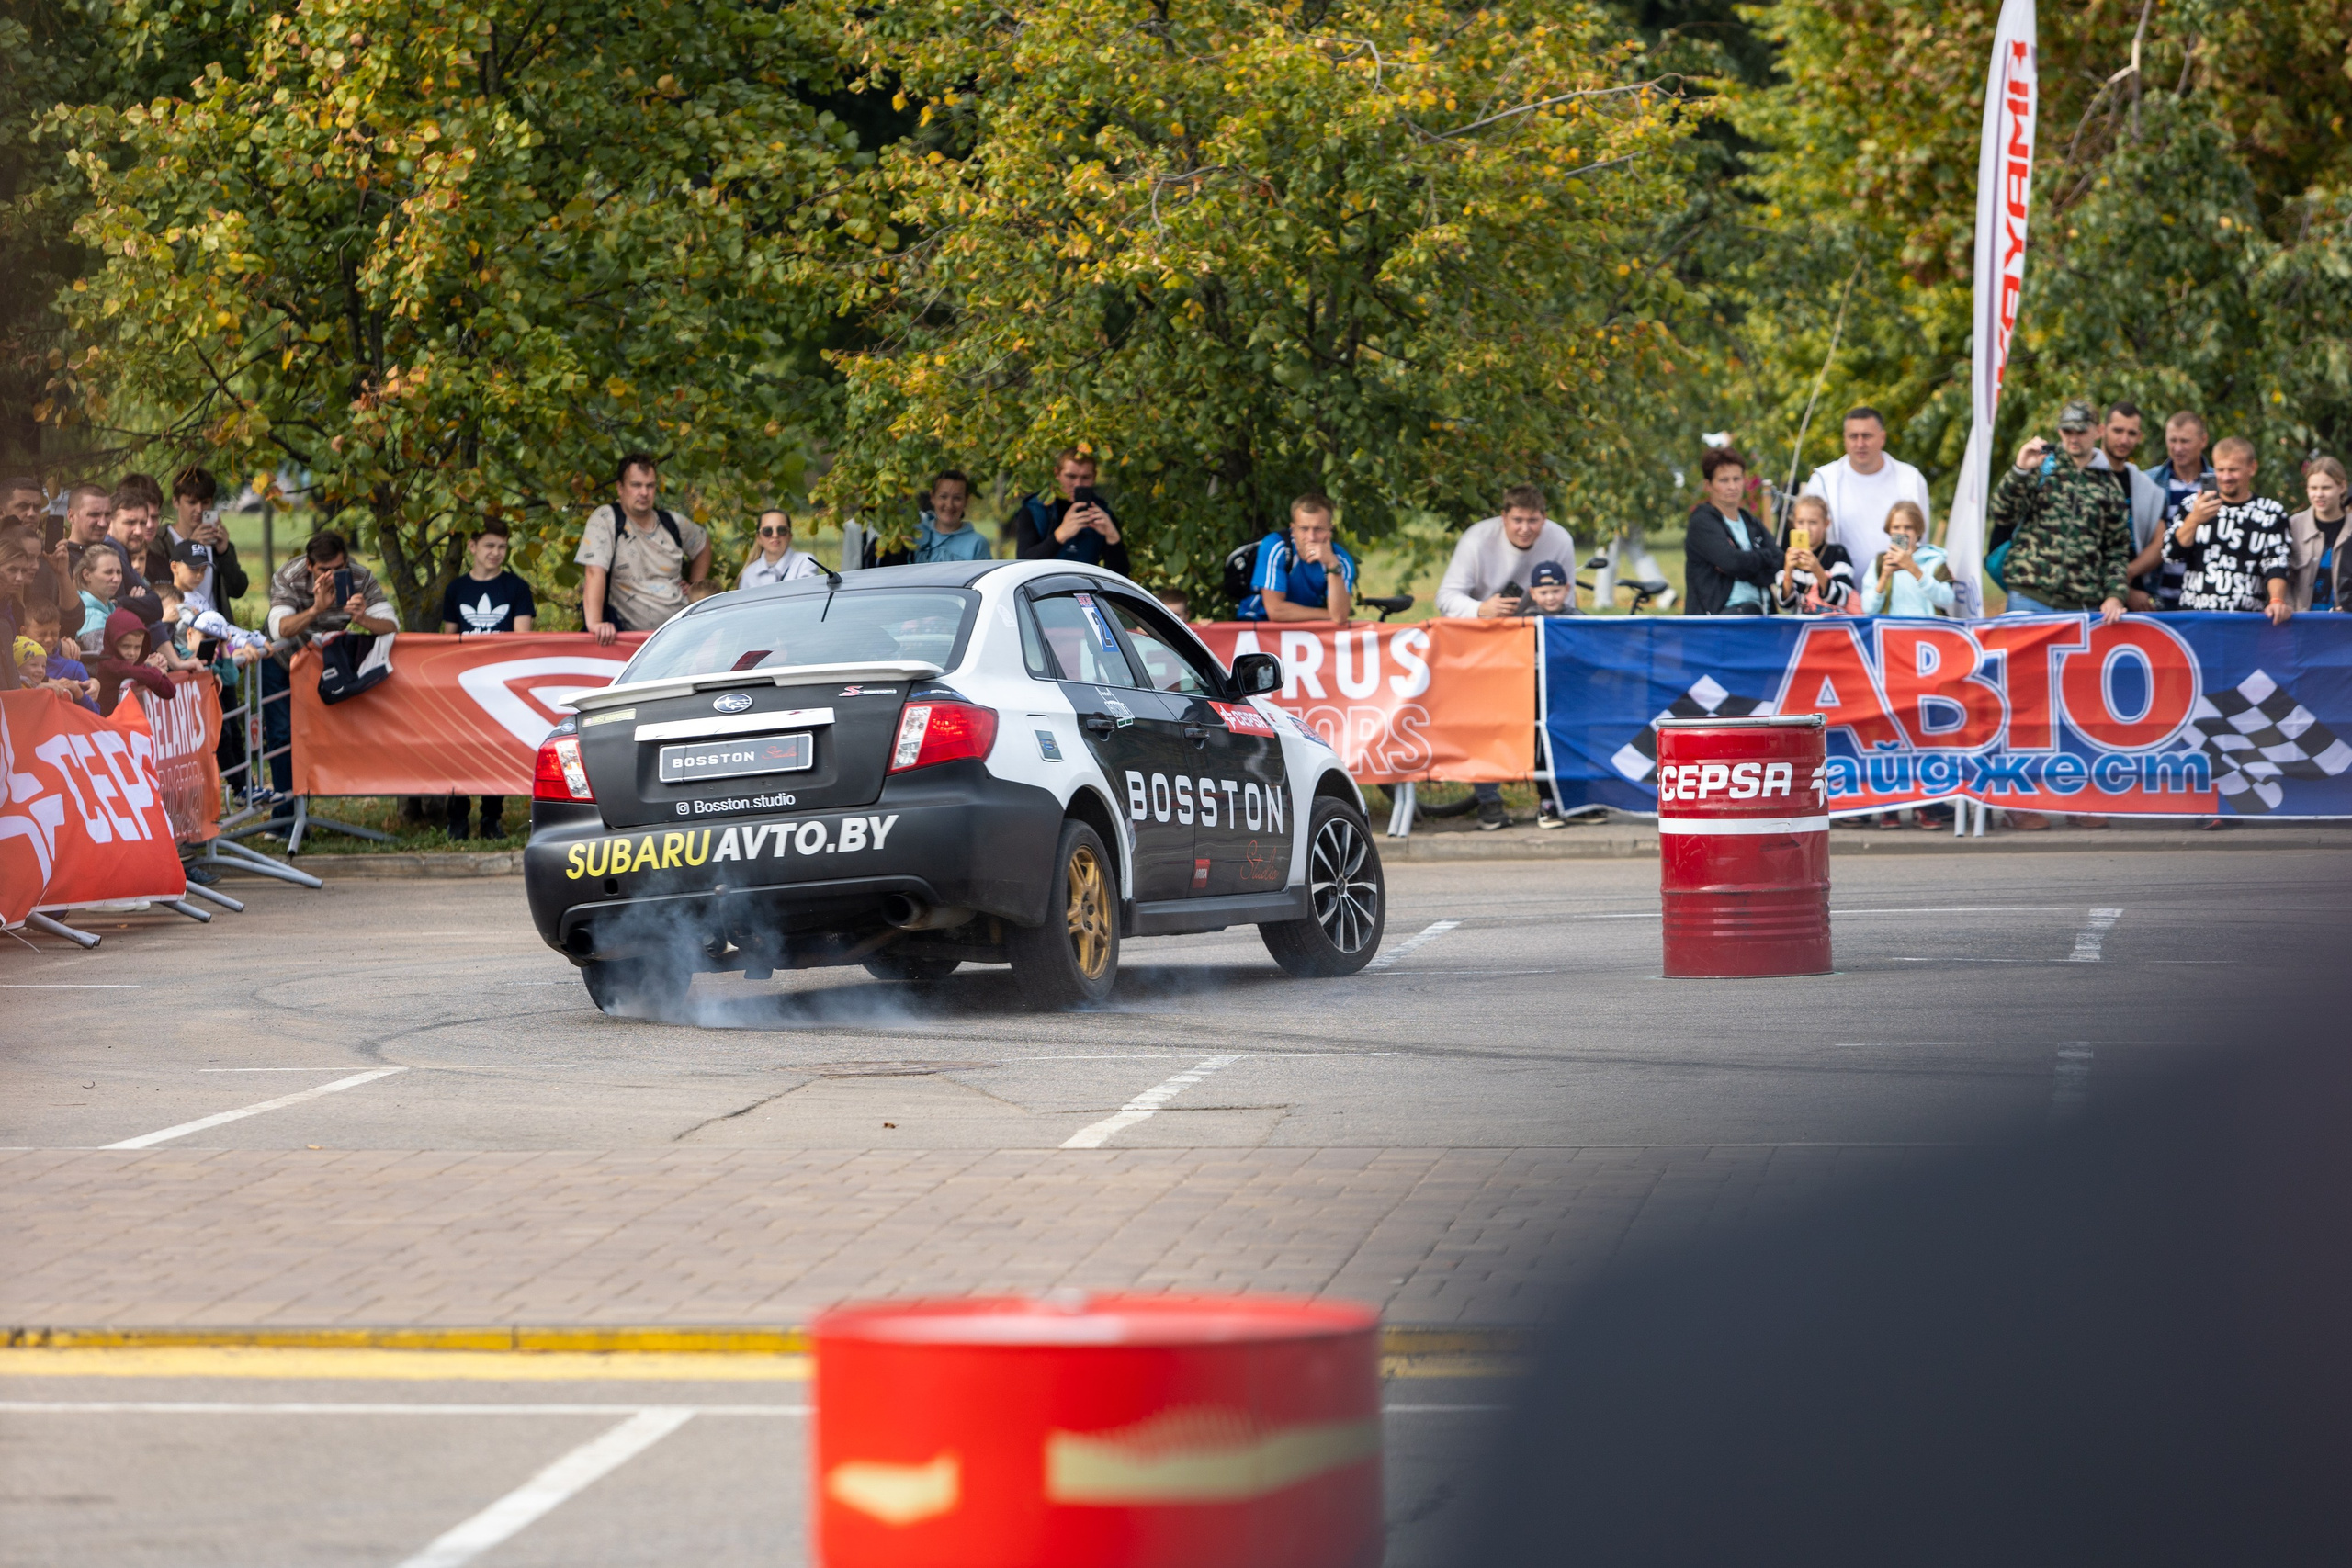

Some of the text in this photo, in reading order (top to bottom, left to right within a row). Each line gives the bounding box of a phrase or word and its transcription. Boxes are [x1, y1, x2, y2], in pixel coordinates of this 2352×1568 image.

[1091, 612, 1114, 648] 2
[1774, 614, 2203, 756] АВТО
[1232, 710, 1269, 729] CEPSA
[1286, 704, 1433, 774] ORS
[672, 751, 755, 768] BOSSTON
[1125, 770, 1283, 834] BOSSTON
[1661, 761, 1793, 802] CEPSA
[695, 793, 796, 814] Bosston.studio
[1240, 840, 1280, 881] Studio
